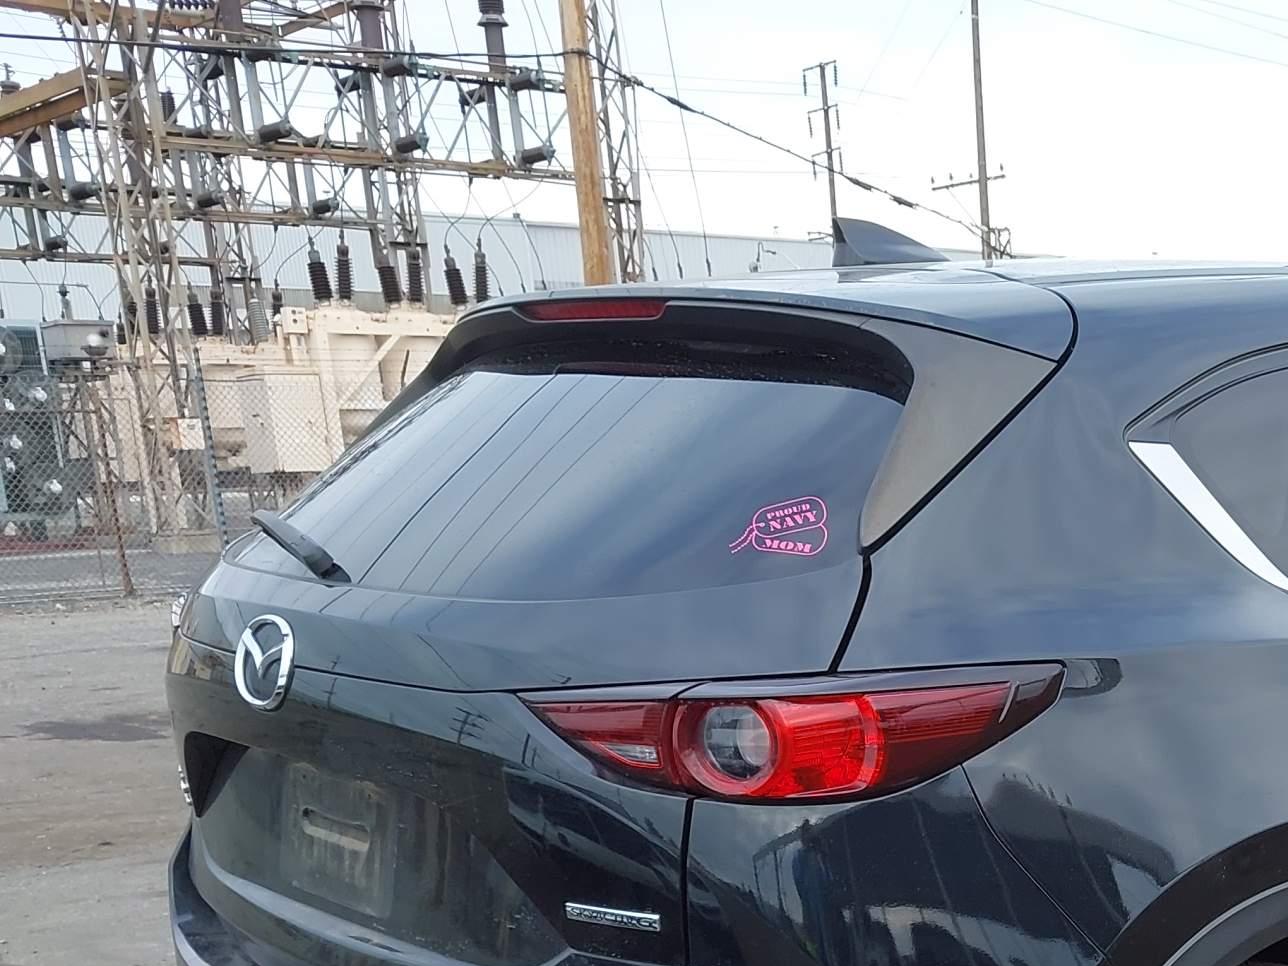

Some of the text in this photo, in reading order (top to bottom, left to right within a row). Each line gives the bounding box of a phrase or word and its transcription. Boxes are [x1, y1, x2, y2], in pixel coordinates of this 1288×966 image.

[767, 503, 810, 519] PROUD
[768, 510, 816, 531] NAVY
[762, 539, 812, 552] MOM
